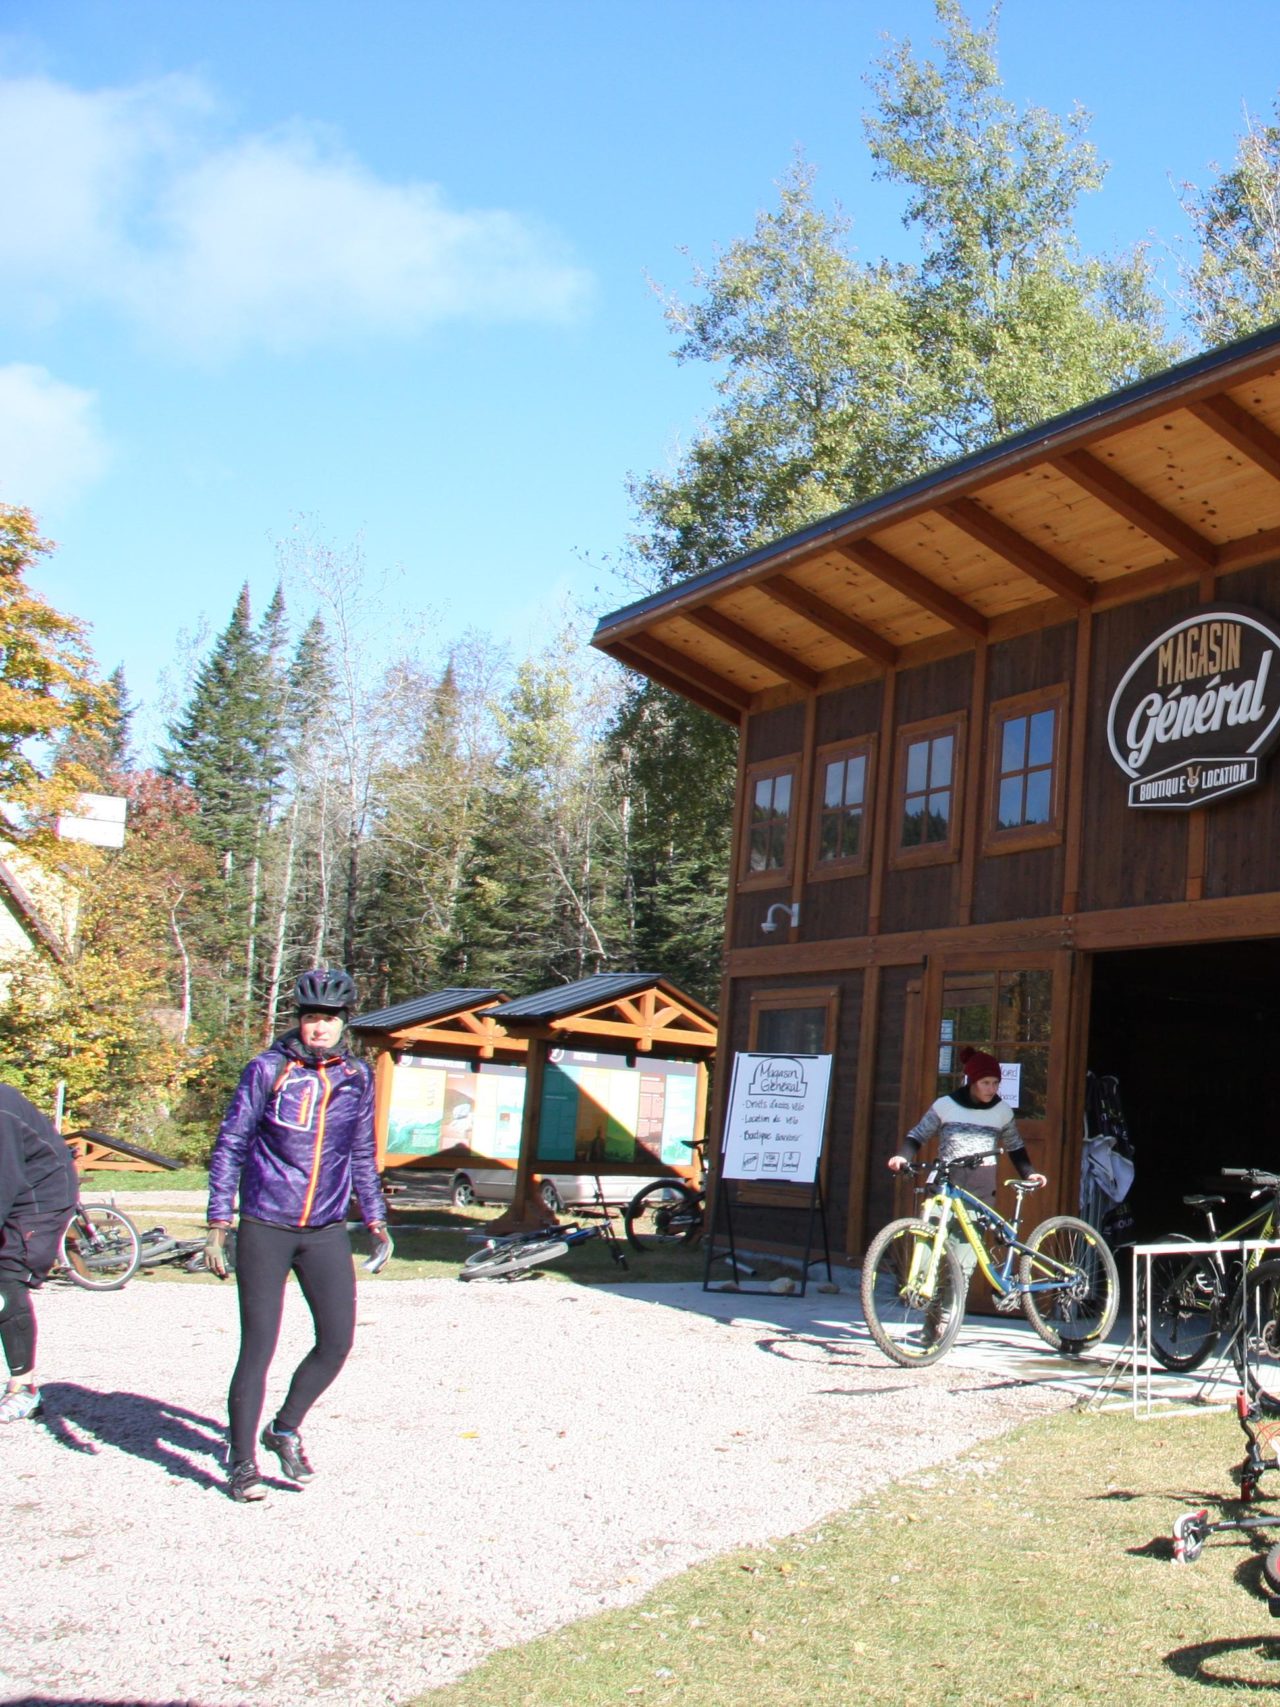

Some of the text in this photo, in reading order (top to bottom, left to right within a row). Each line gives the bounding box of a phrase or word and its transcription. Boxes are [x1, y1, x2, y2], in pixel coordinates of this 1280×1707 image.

[1157, 622, 1242, 687] MAGASIN
[1126, 649, 1273, 768] Général
[1139, 762, 1247, 801] BOUTIQUE LOCATION
